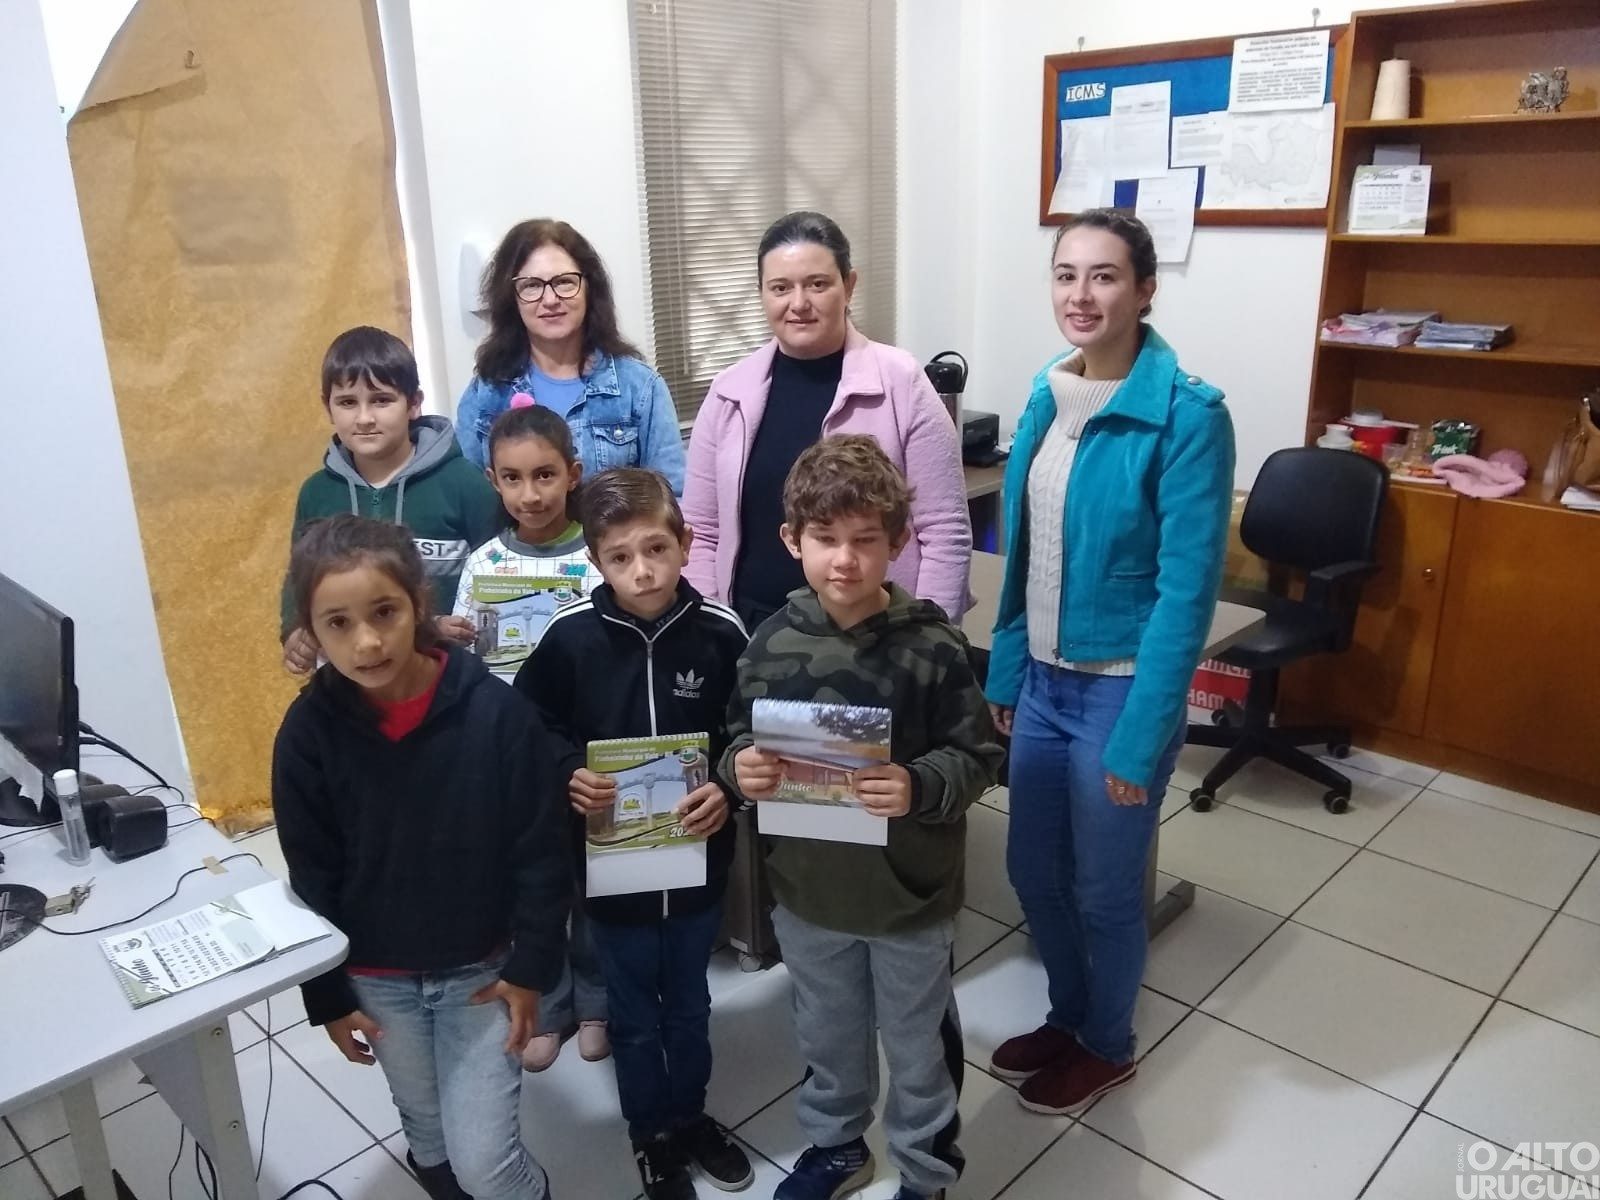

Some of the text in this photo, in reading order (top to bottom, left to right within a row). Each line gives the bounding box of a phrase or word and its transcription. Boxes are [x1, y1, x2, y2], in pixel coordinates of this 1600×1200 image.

[1067, 84, 1105, 101] ICMS
[413, 541, 446, 556] ST
[672, 688, 700, 698] adidas
[131, 958, 159, 985] Junho
